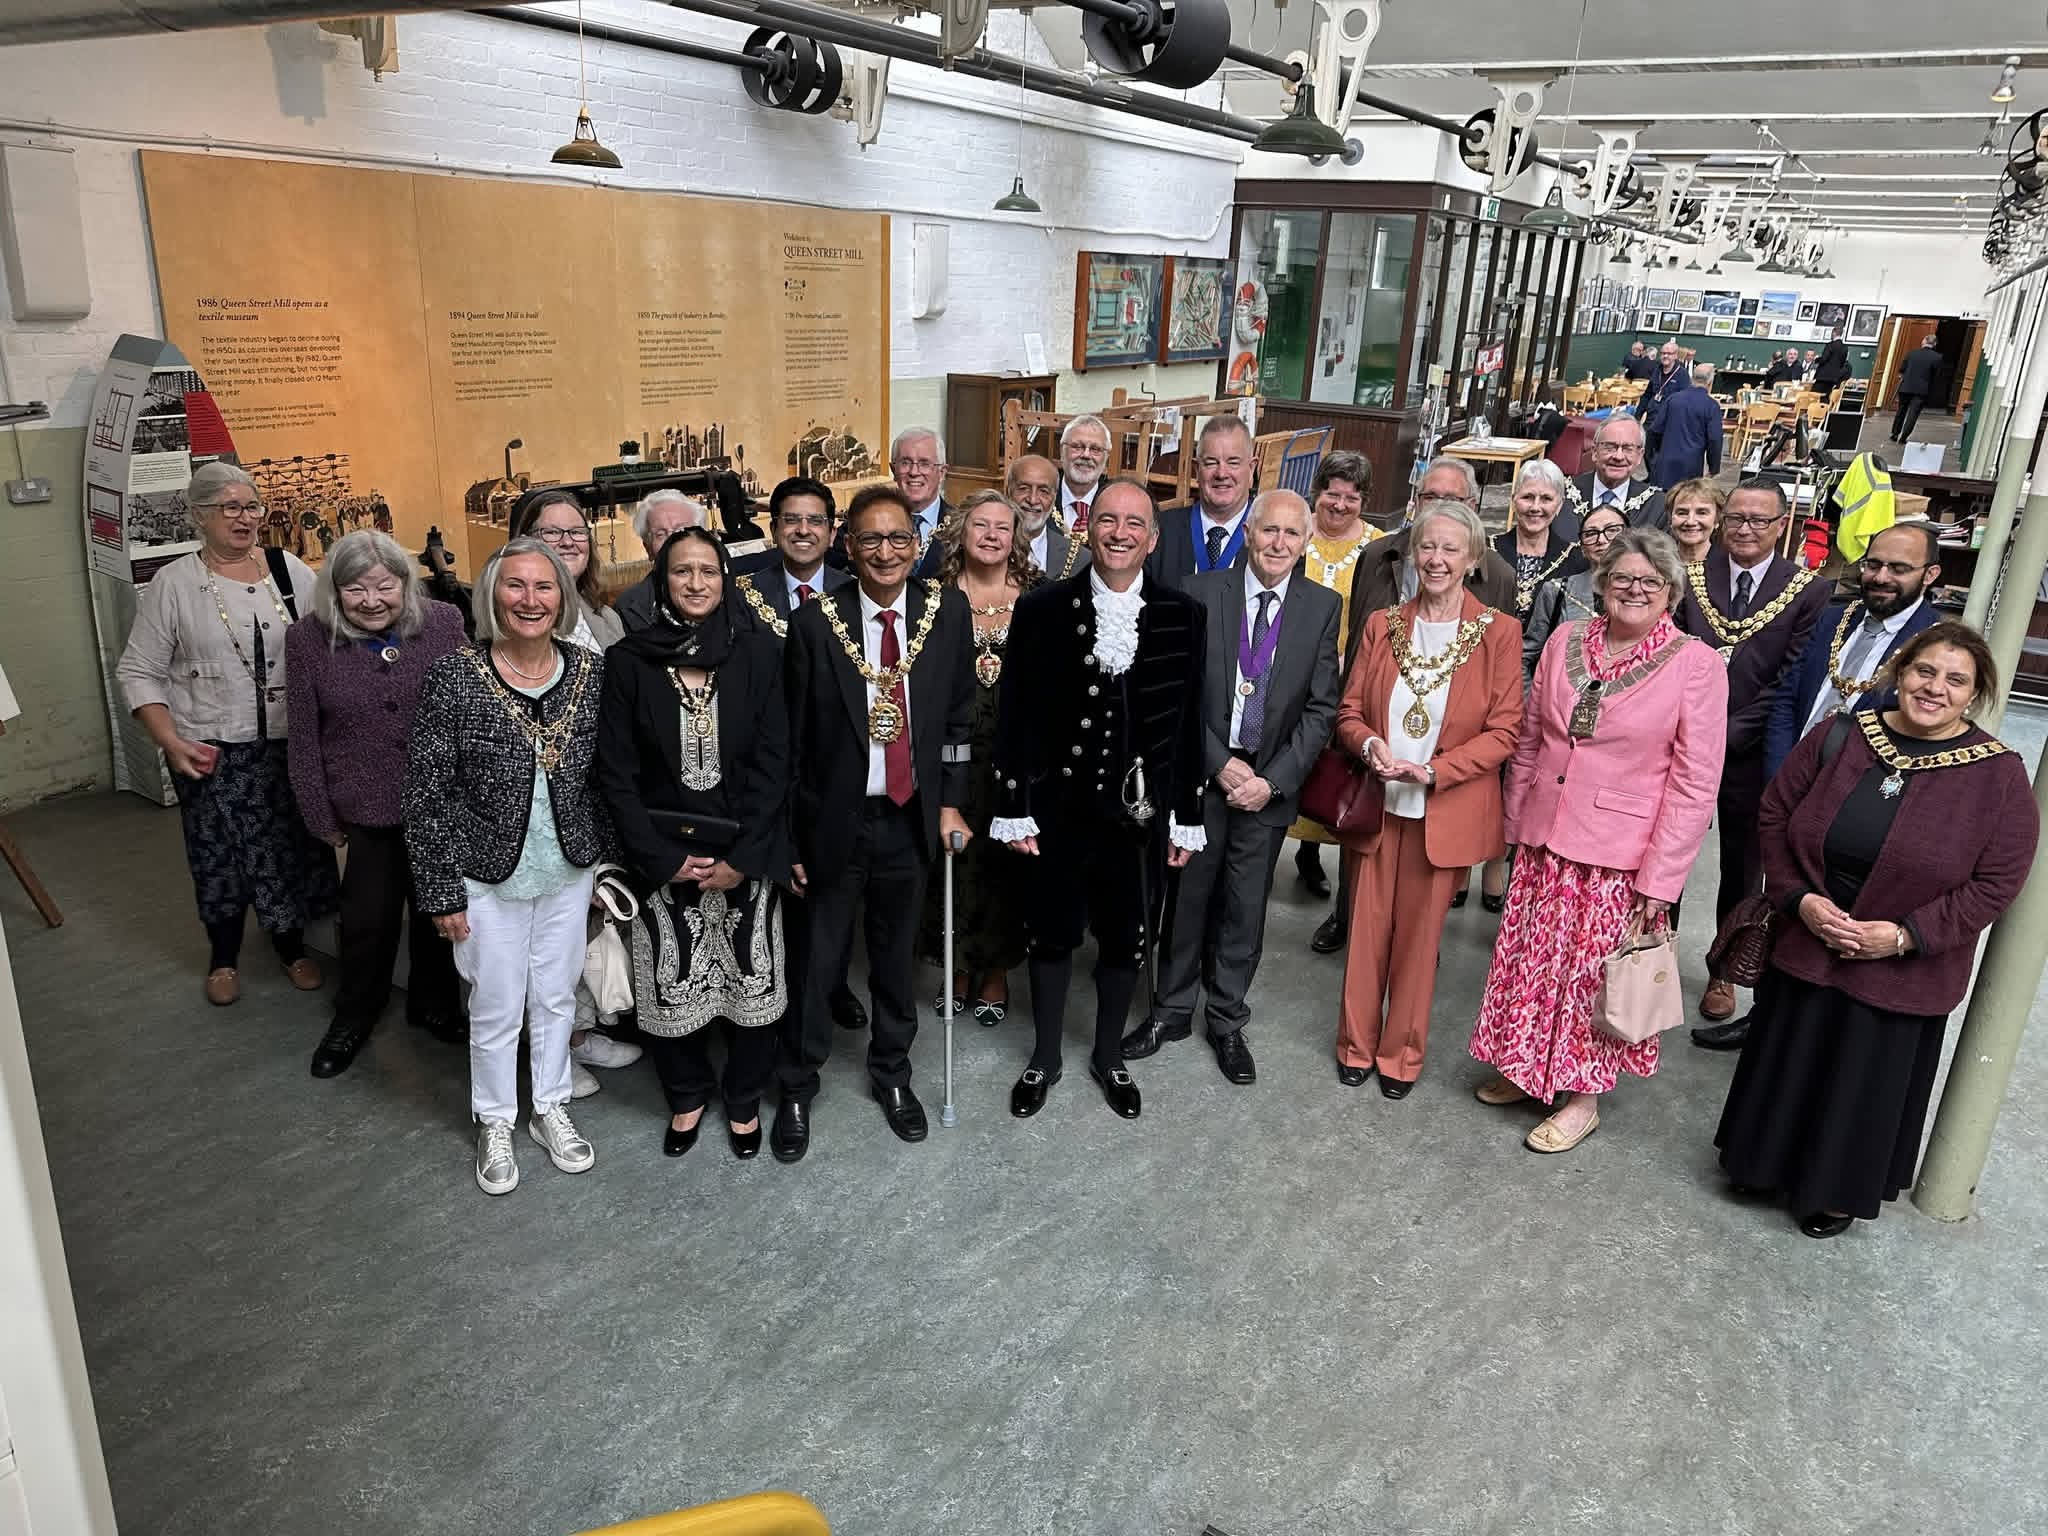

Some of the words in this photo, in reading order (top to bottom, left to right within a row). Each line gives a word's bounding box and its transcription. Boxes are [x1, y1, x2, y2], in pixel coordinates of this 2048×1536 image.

[784, 246, 813, 259] QUEEN
[814, 247, 843, 259] STREET
[845, 248, 865, 260] MILL
[197, 299, 218, 308] 1986
[220, 299, 247, 310] Queen
[249, 299, 272, 308] Street
[273, 299, 291, 308] Mill
[292, 301, 313, 310] opens
[199, 312, 225, 321] textile
[449, 311, 466, 320] 1894
[467, 311, 486, 322] Queen
[487, 311, 505, 320] Street
[506, 311, 519, 320] Mill
[526, 311, 539, 319] built
[651, 311, 660, 320] The
[201, 336, 215, 344] The
[215, 336, 238, 344] textile
[239, 336, 267, 345] industry
[268, 336, 289, 345] began
[297, 335, 320, 343] decline
[321, 335, 341, 344] during
[450, 331, 468, 339] Queen
[468, 331, 485, 339] Street
[216, 347, 237, 355] 1950s
[309, 345, 341, 353] developed
[204, 358, 222, 366] their
[238, 357, 259, 365] textile
[296, 355, 305, 364] By
[323, 354, 343, 363] Queen
[205, 368, 229, 377] Street
[228, 368, 241, 376] Mill
[257, 367, 269, 375] still
[297, 365, 308, 373] but
[310, 365, 319, 373] no
[319, 365, 338, 374] longer
[207, 379, 233, 388] making
[264, 376, 284, 385] finally
[284, 376, 305, 384] closed
